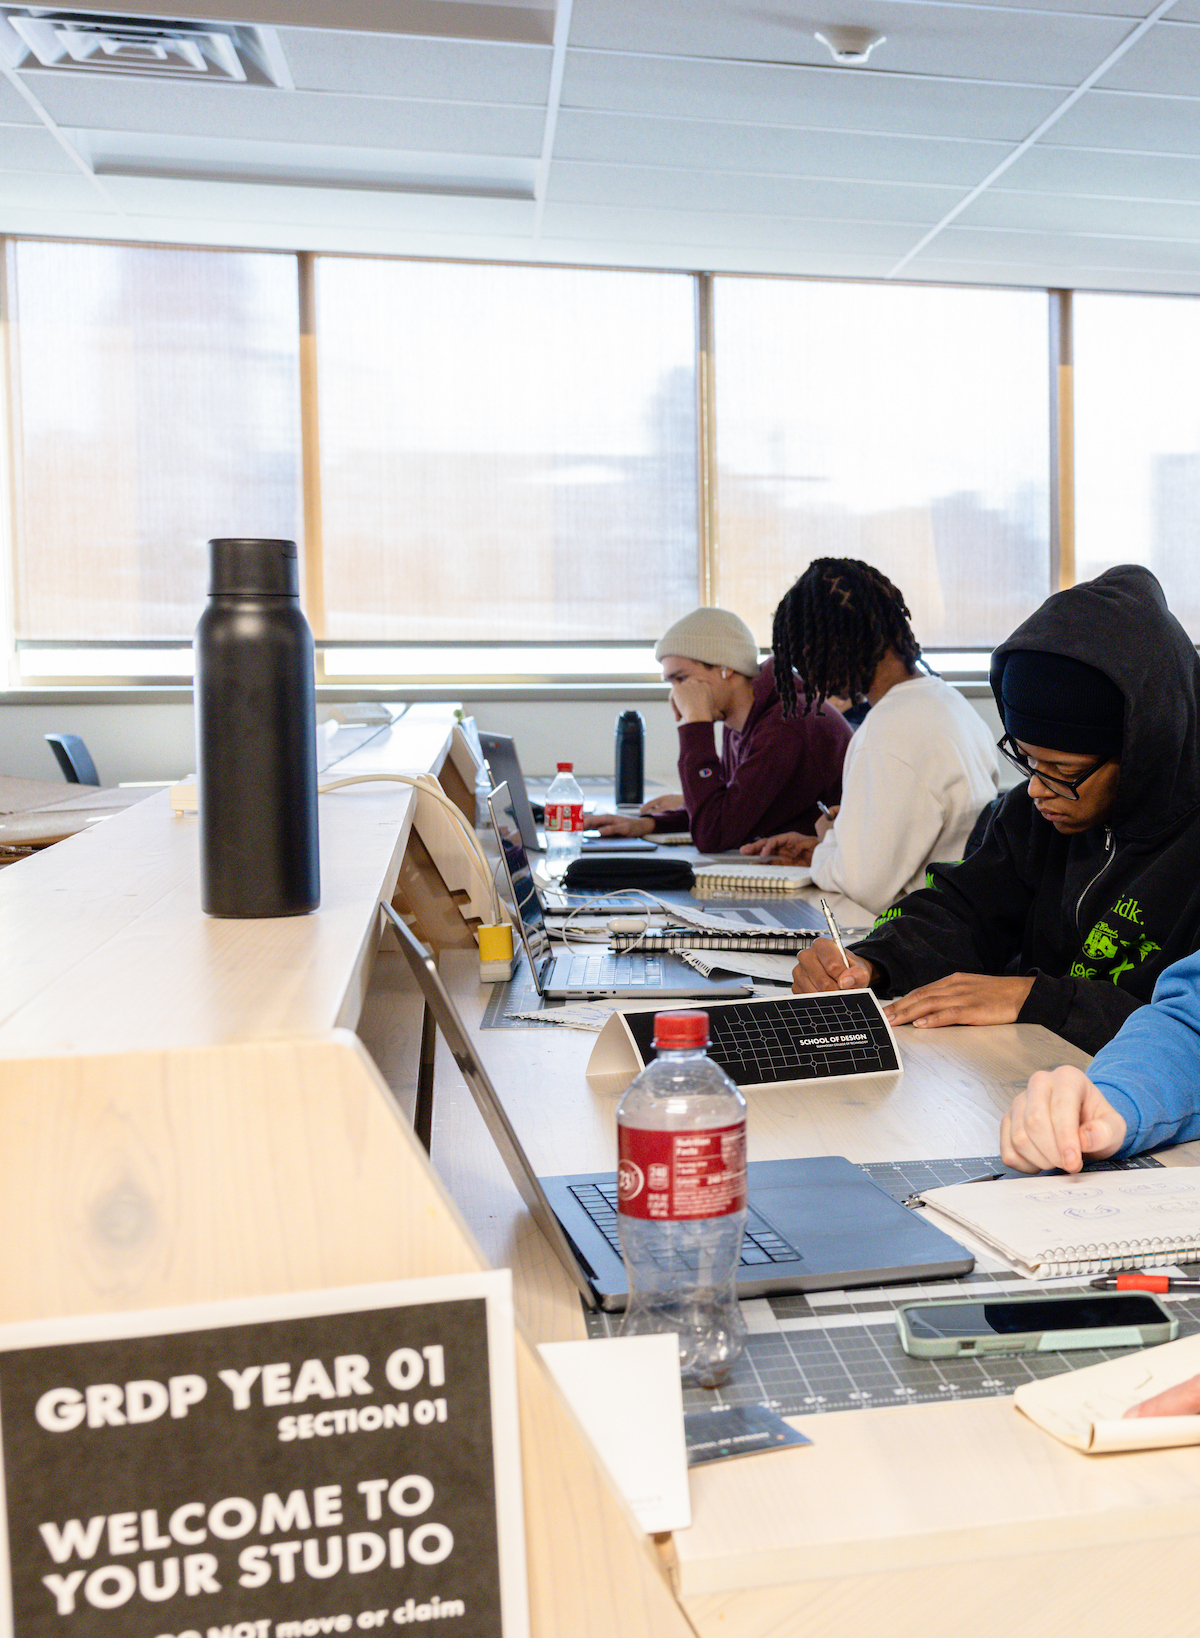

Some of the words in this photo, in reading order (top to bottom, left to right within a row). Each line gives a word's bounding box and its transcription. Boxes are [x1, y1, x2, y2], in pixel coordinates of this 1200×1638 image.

[799, 1037, 830, 1046] SCHOOL
[830, 1036, 840, 1044] OF
[840, 1034, 867, 1042] DESIGN
[35, 1374, 207, 1432] GRDP
[218, 1354, 374, 1411] YEAR
[385, 1344, 446, 1391] 01
[277, 1403, 409, 1442] SECTION
[413, 1398, 448, 1425] 01
[38, 1485, 343, 1564] WELCOME
[357, 1474, 435, 1522] TO
[42, 1552, 222, 1616] YOUR
[238, 1522, 455, 1589] STUDIO
[275, 1614, 353, 1638] move
[357, 1606, 389, 1630] or
[393, 1595, 466, 1624] claim
